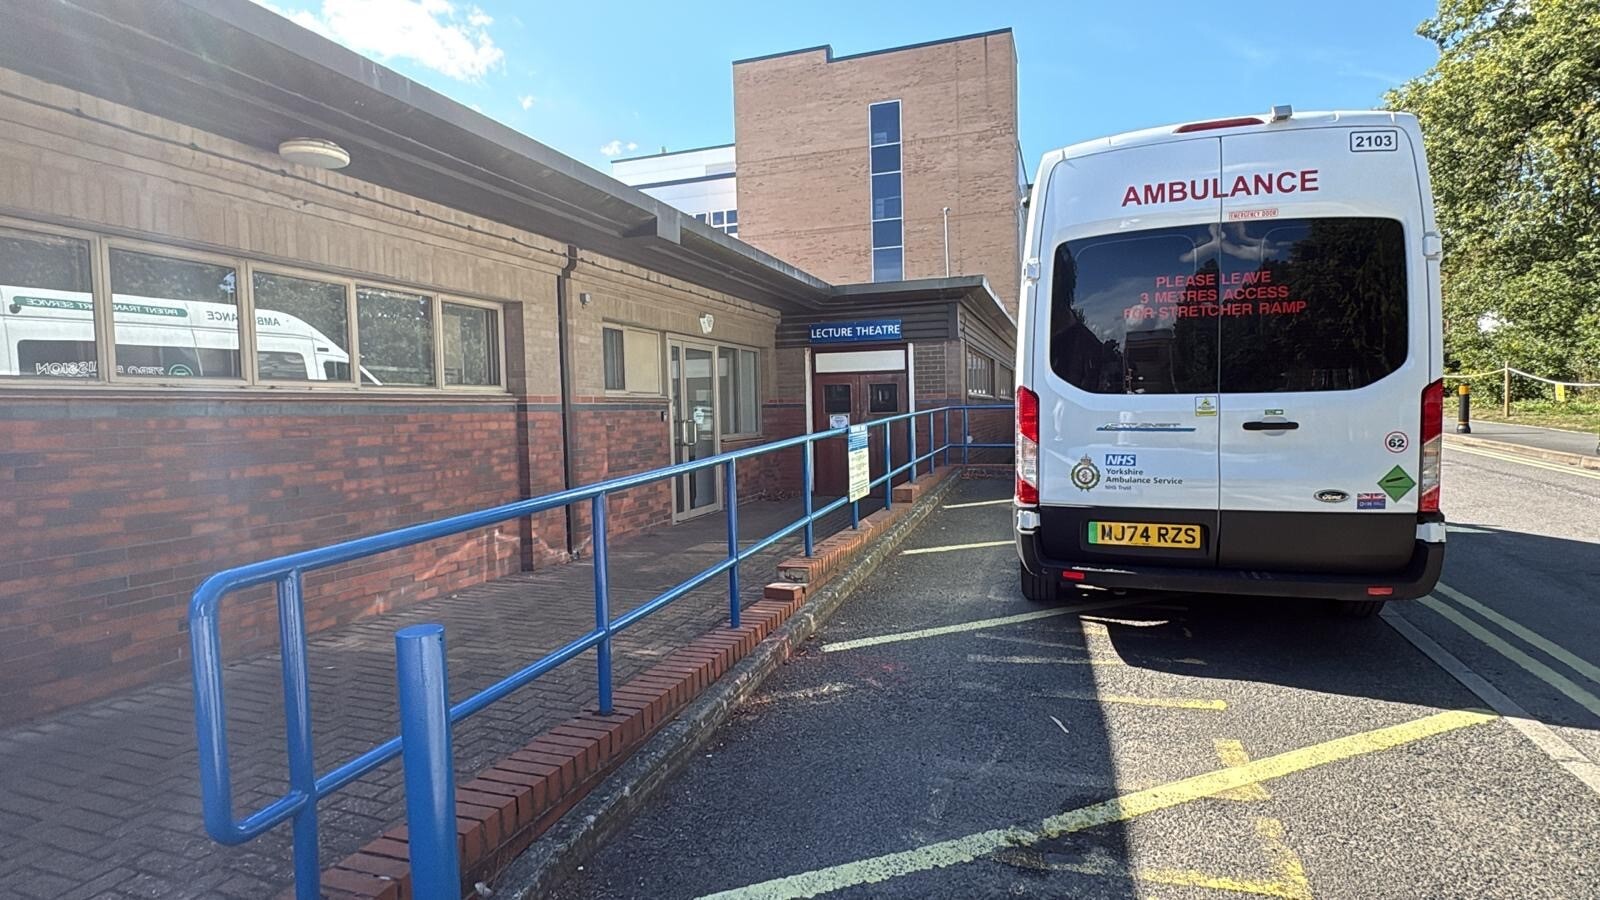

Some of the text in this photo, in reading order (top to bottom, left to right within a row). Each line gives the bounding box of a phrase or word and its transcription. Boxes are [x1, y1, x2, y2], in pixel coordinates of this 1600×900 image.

[1355, 135, 1392, 147] 2103
[1121, 169, 1319, 207] AMBULANCE
[1156, 270, 1272, 288] PLEASE LEAVE
[1140, 286, 1289, 304] 3 METRES ACCESS
[1124, 301, 1307, 320] FOR STRETCHER RAMP
[811, 325, 900, 338] LECTURE THEATRE
[1388, 439, 1405, 447] 62
[1107, 456, 1134, 465] NHS
[1106, 476, 1183, 485] Ambulance Service
[1101, 524, 1196, 544] MJ74 RZS
